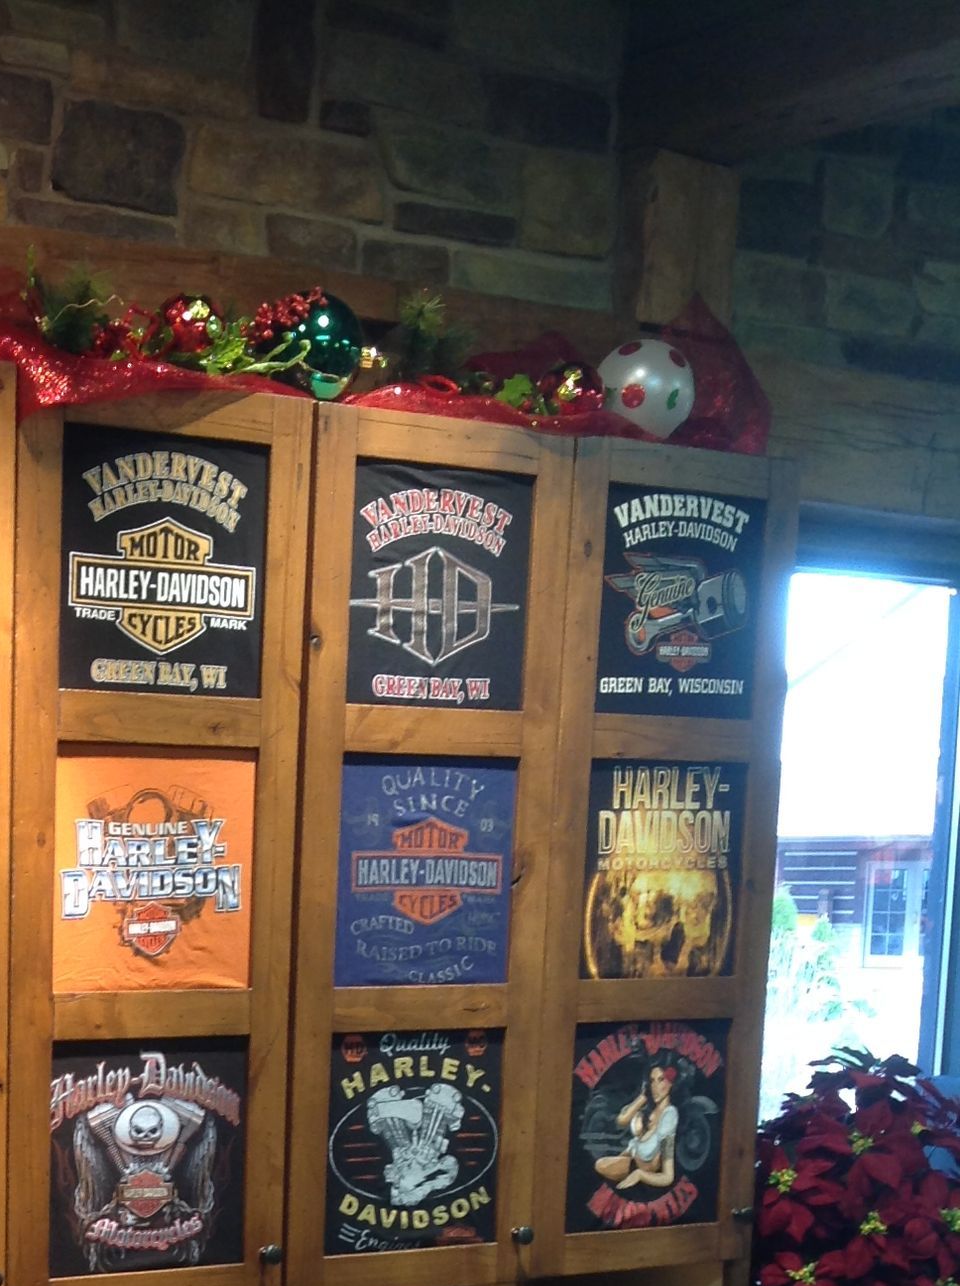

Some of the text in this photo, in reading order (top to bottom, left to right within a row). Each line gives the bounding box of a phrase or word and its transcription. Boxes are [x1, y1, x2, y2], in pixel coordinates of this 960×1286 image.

[82, 451, 248, 509] VANDERVEST
[88, 480, 241, 533] HARLEY-DAVIDSON
[360, 488, 513, 535] VANDERVEST
[614, 494, 750, 534] VANDERVEST
[129, 526, 200, 561] MOTOR
[366, 513, 506, 556] HARLEY-DAVIDSON
[623, 521, 739, 552] HARLEY-DAVIDSON
[80, 566, 246, 608] HARLEY-DAVIDSON
[74, 607, 116, 621] TRADE
[128, 613, 196, 645] CYCLES
[209, 617, 247, 630] MARK
[91, 658, 156, 686] GREEN
[200, 665, 228, 688] WI
[372, 674, 428, 698] GREEN
[466, 678, 491, 699] WI
[600, 677, 744, 697] GREEN BAY, WISCONSIN
[381, 767, 485, 800] QUALITY
[612, 766, 730, 810] HARLEY-
[393, 793, 469, 817] SINCE
[75, 818, 227, 868] HARLEY-
[109, 821, 187, 835] GENUINE
[400, 821, 461, 848] MOTOR
[598, 810, 730, 855] DAVIDSON
[357, 858, 497, 887] HARLEY-DAVIDSON
[597, 856, 728, 871] MOTORCYCLES
[60, 864, 242, 920] DAVIDSON
[398, 893, 459, 919] CYCLES
[350, 914, 415, 935] CRAFTED
[408, 955, 474, 984] CLASSIC
[379, 1032, 451, 1056] Quality
[338, 1186, 491, 1230] DAVIDSON
